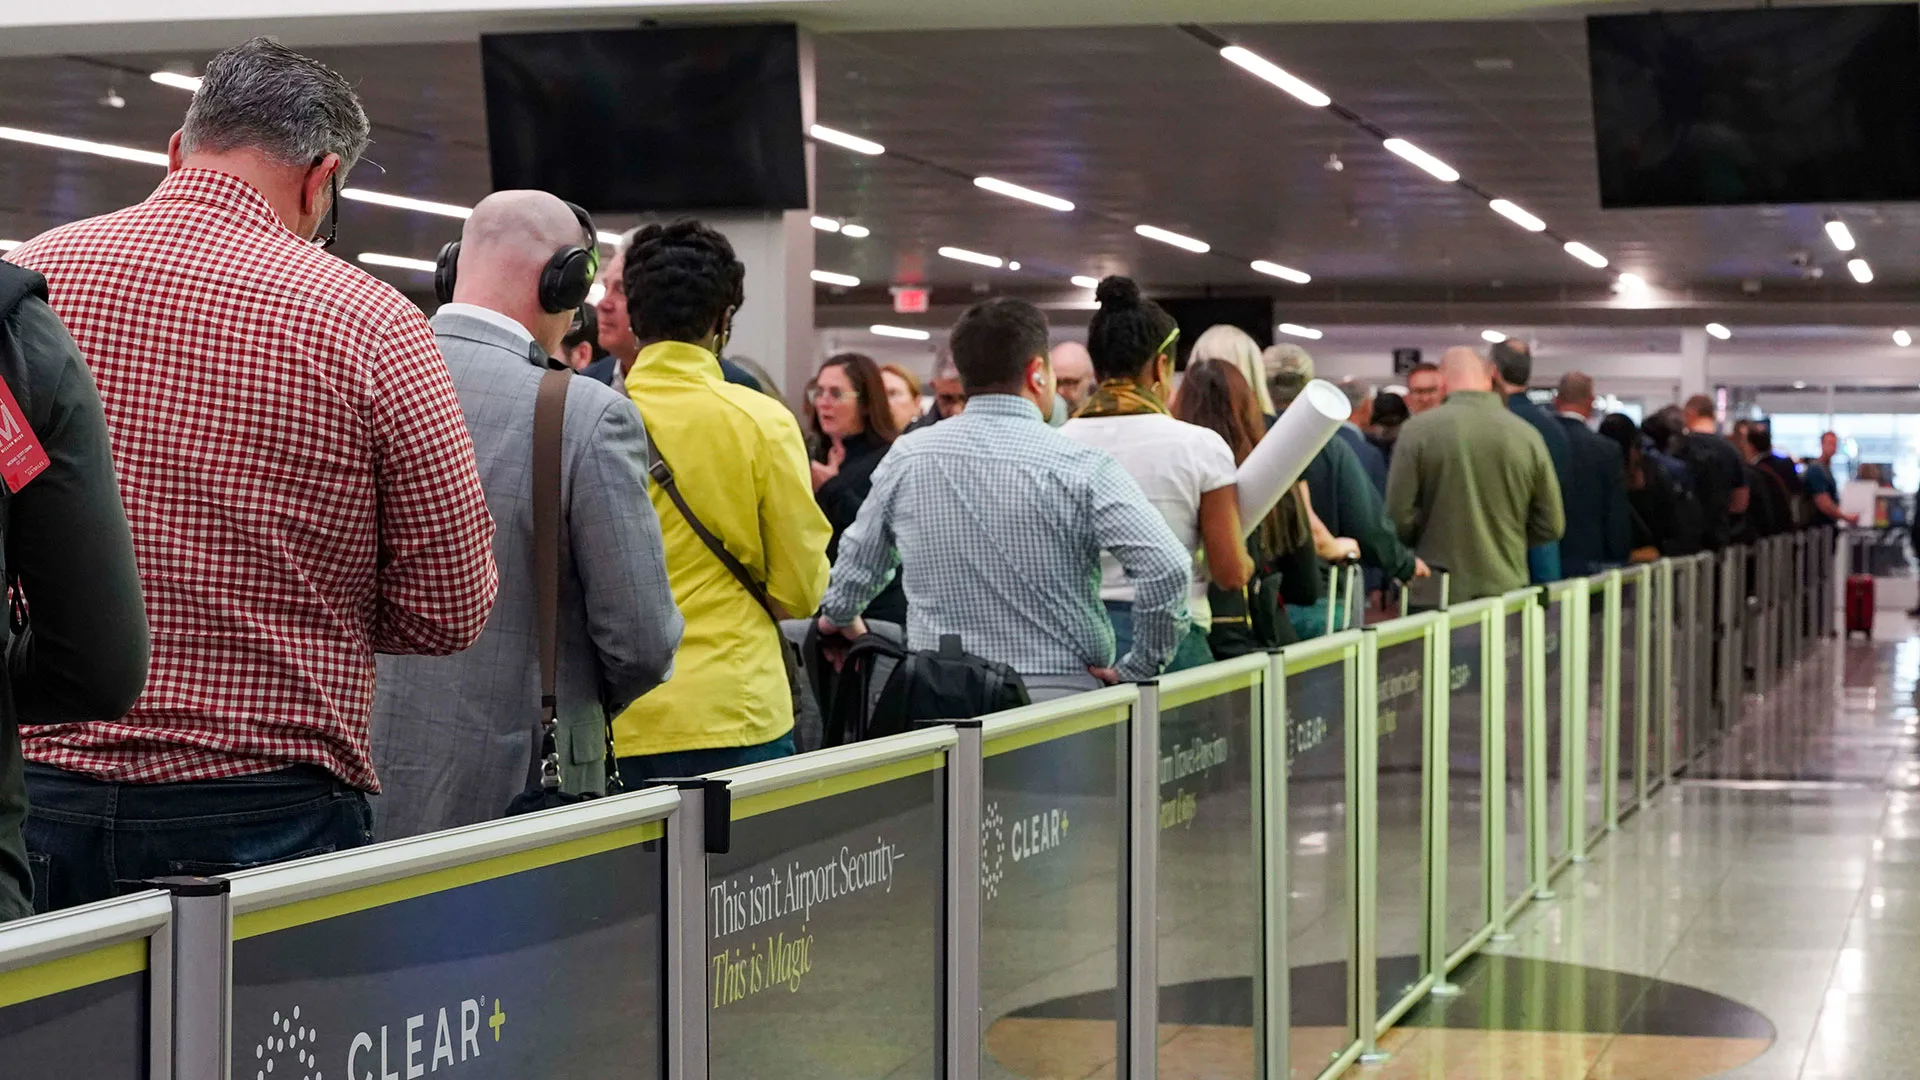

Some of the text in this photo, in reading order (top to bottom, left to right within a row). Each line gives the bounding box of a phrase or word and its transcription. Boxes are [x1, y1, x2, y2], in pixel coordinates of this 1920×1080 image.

[710, 875, 745, 939] This
[748, 868, 782, 928] isn't
[784, 855, 838, 922] Airport
[712, 925, 814, 1009] This is Magic
